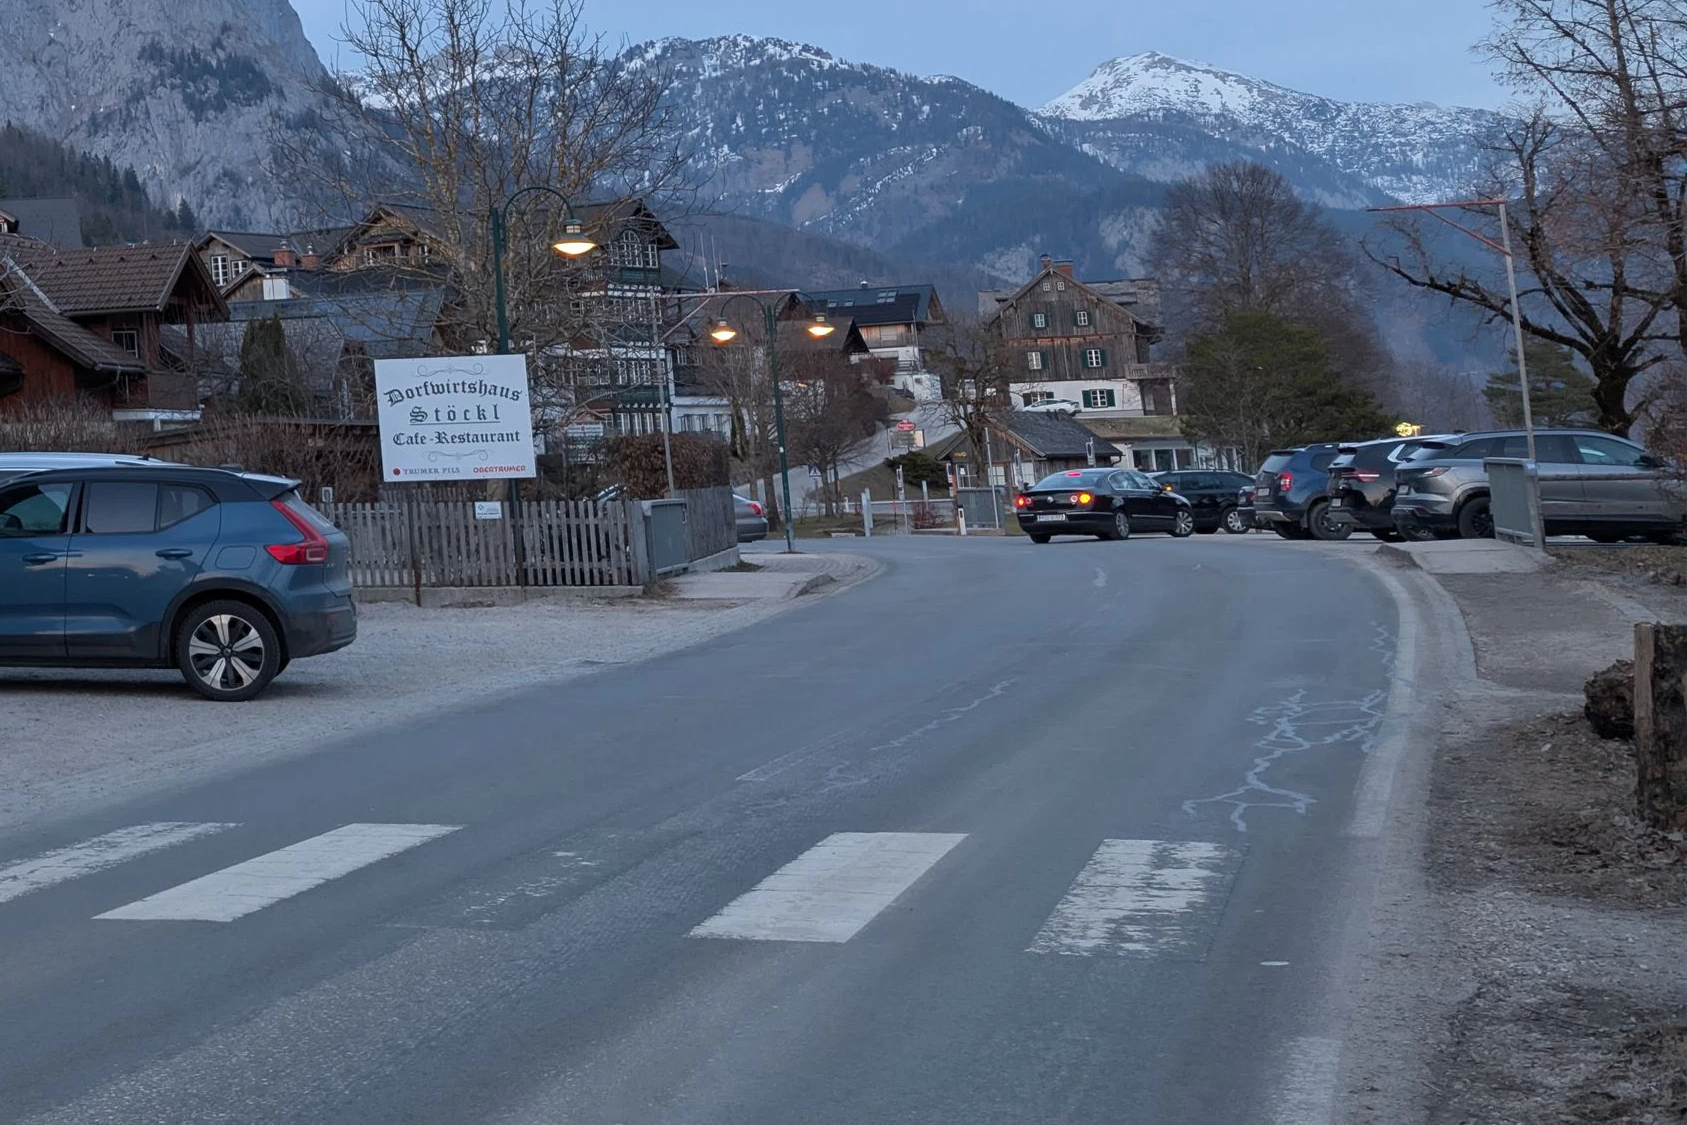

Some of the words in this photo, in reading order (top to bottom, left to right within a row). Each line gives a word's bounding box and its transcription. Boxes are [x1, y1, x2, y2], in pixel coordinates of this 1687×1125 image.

[383, 378, 523, 408] Dorfwirtshaus
[408, 403, 501, 424] Stöckl
[402, 467, 440, 475] TRUMER
[442, 466, 460, 474] PILS
